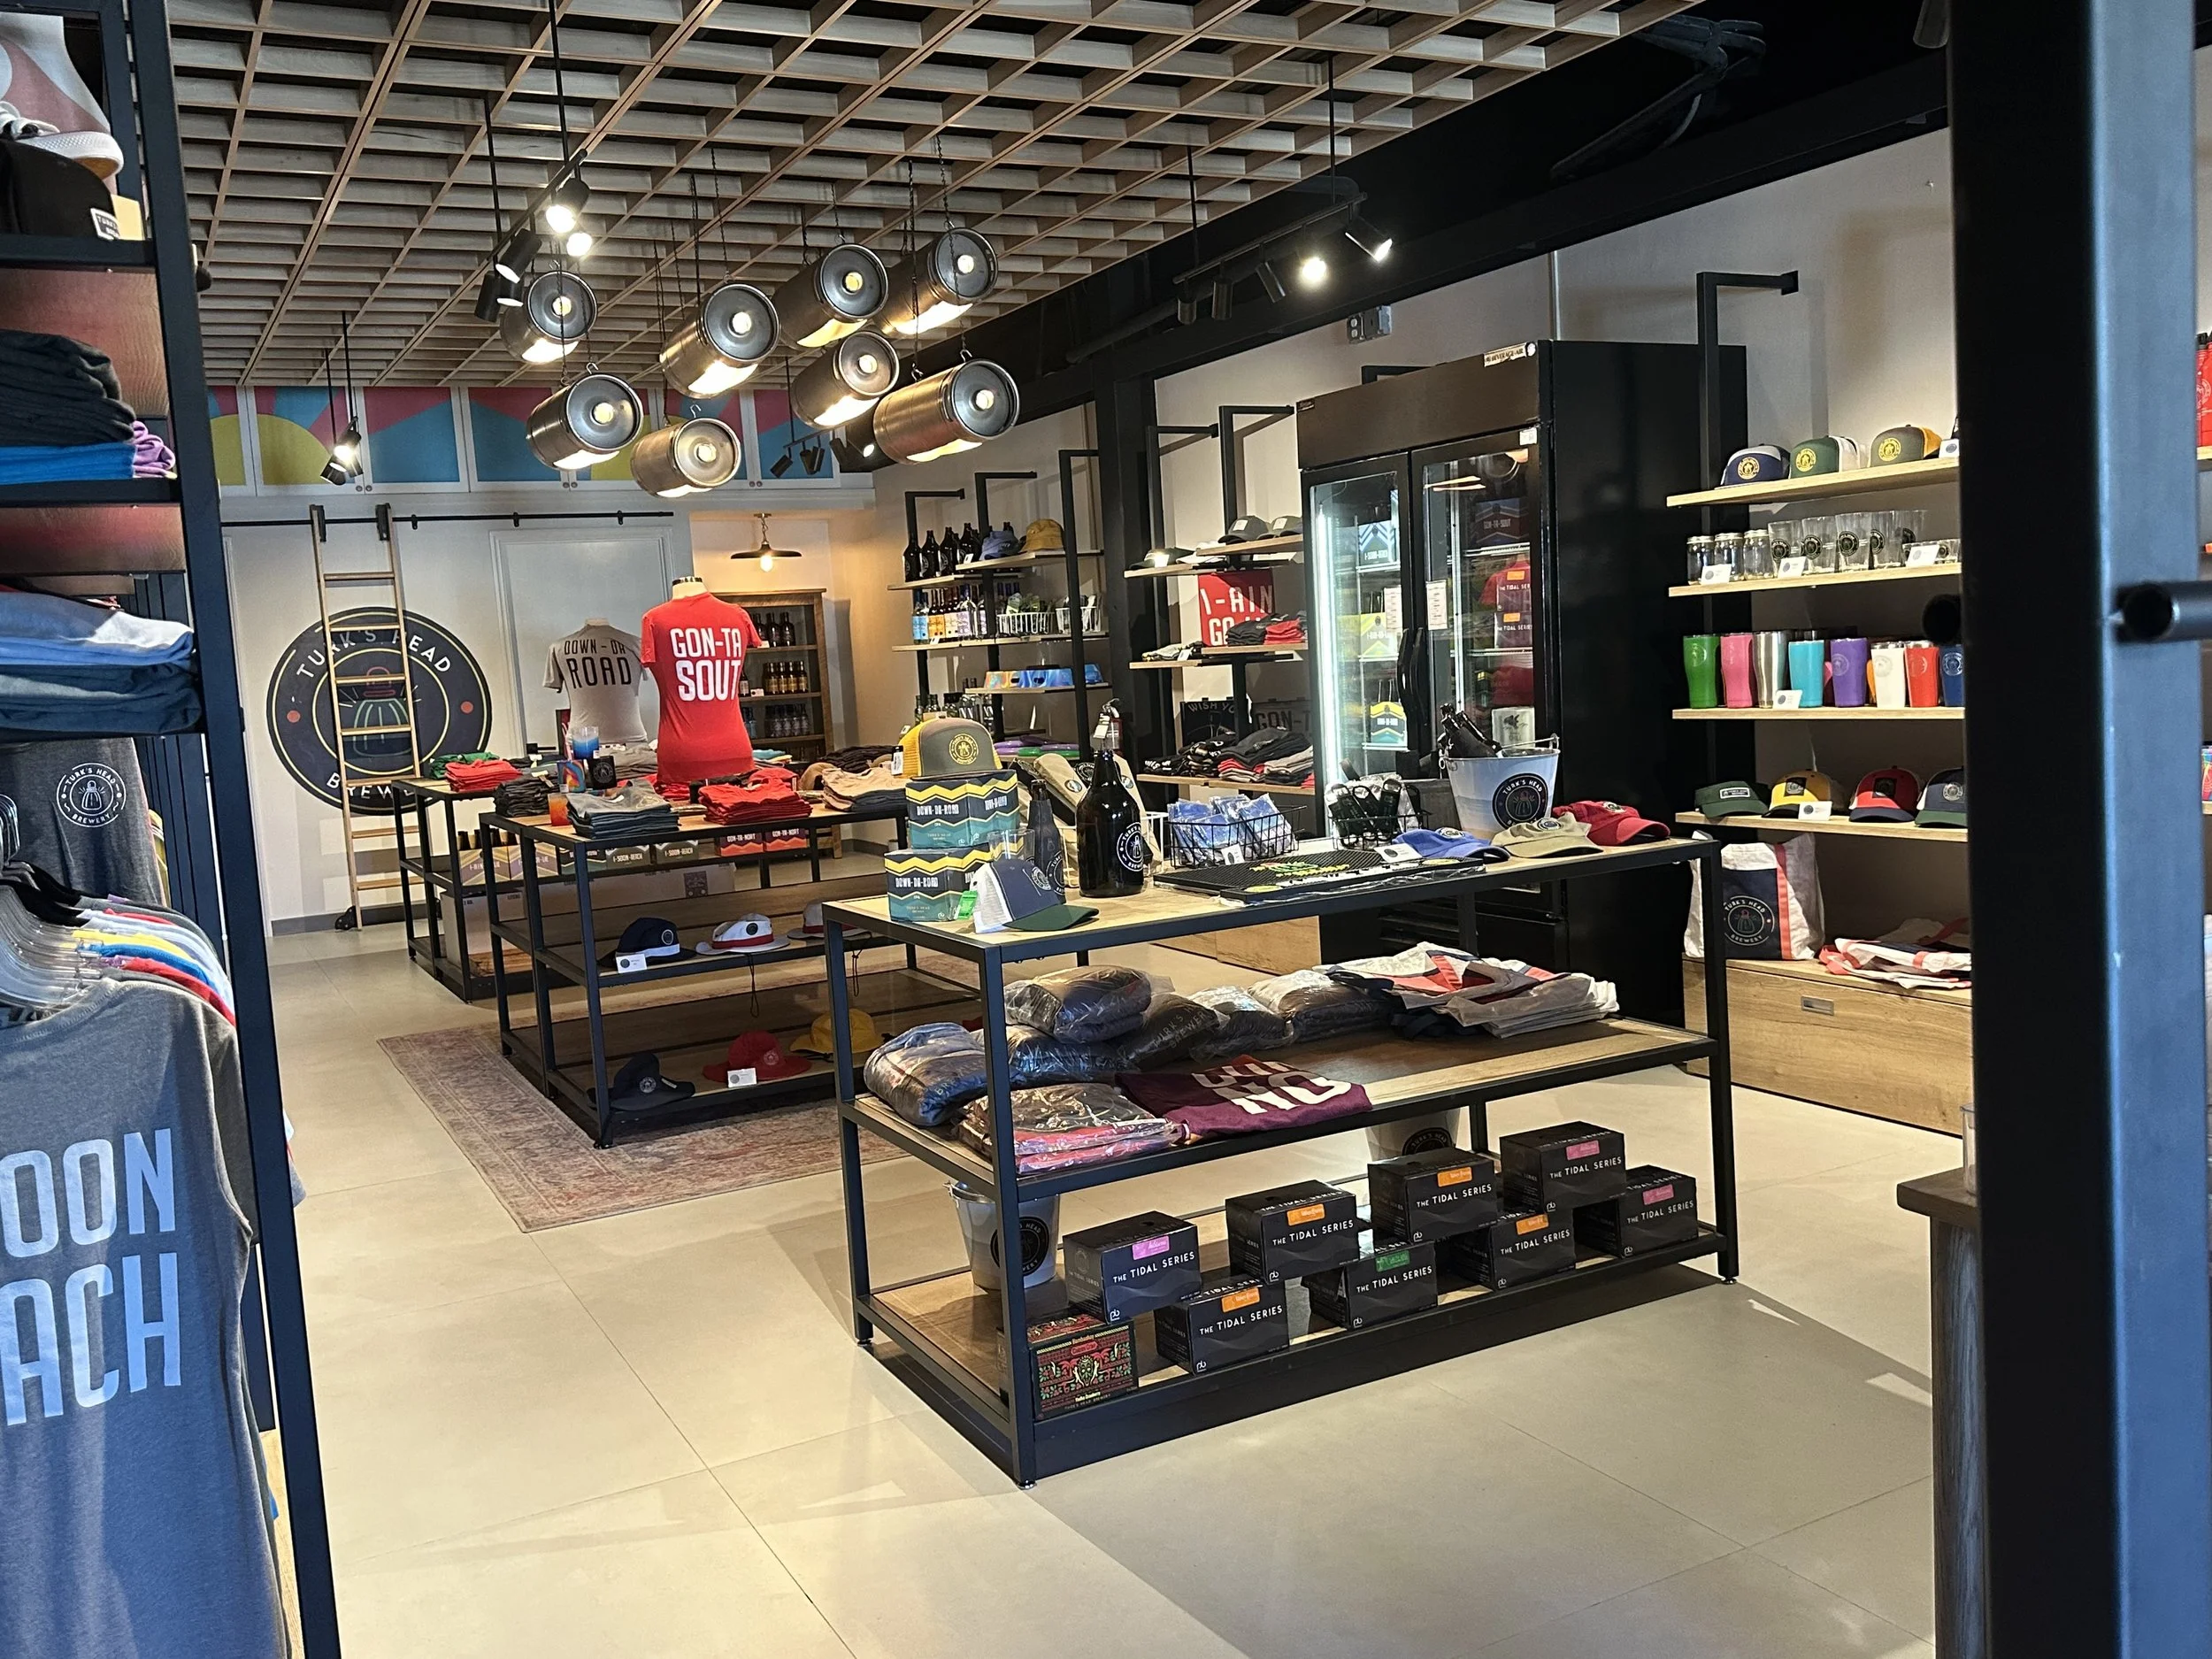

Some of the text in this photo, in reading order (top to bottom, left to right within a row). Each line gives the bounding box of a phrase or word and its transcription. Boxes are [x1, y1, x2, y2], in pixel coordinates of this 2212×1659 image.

[564, 639, 597, 656] DOWN
[670, 627, 741, 657] GON-TA
[566, 657, 632, 688] ROAD
[675, 659, 741, 702] SOUT
[1187, 702, 1217, 712] WISH
[65, 767, 116, 785] TURK'S HEAD
[1502, 779, 1543, 795] TURK'S HEAD
[72, 813, 111, 824] BREWERY
[1724, 899, 1765, 913] TURK'S HEAD
[1731, 933, 1763, 942] BREWERY
[1564, 1164, 1590, 1176] TIDAL
[1594, 1156, 1622, 1170] SERIES
[1417, 1184, 1493, 1208] THE TIDAL SERIES
[1626, 1200, 1694, 1225] THE TIDAL SERIES
[1025, 1224, 1041, 1233] HEAD
[1272, 1219, 1354, 1246] THE TIDAL SERIES
[1500, 1229, 1571, 1256] THE TIDAL SERIES
[1112, 1251, 1195, 1284] THE TIDAL SERIES
[1356, 1265, 1432, 1294] THE TIDAL SERIES
[1199, 1304, 1283, 1335] THE TIDAL SERIES
